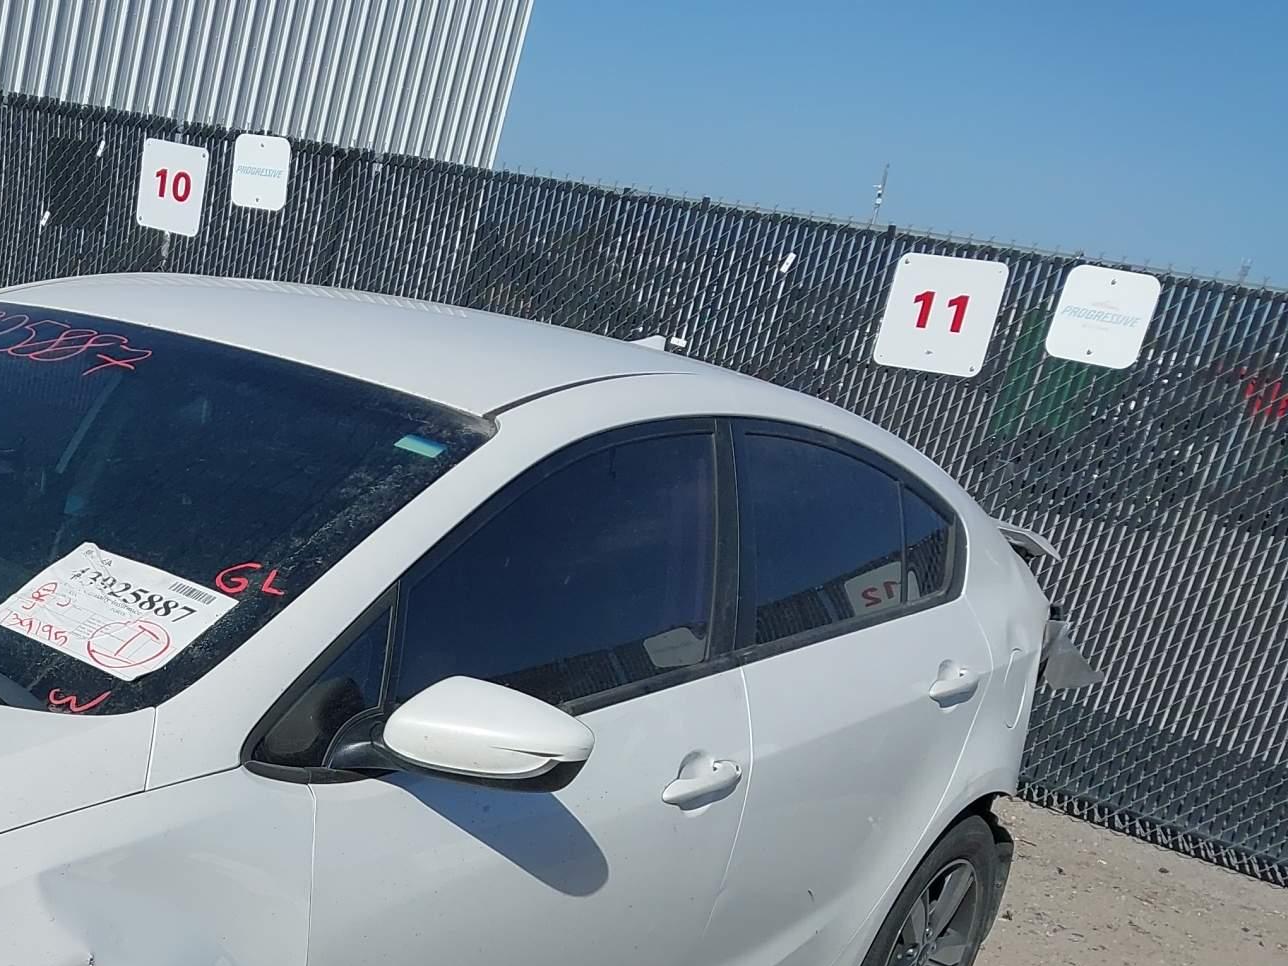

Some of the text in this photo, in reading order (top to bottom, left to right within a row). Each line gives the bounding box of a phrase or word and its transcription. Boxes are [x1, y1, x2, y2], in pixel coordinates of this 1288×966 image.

[156, 168, 192, 202] 10
[913, 290, 970, 333] 11
[1061, 305, 1141, 328] PROGRESSIVE
